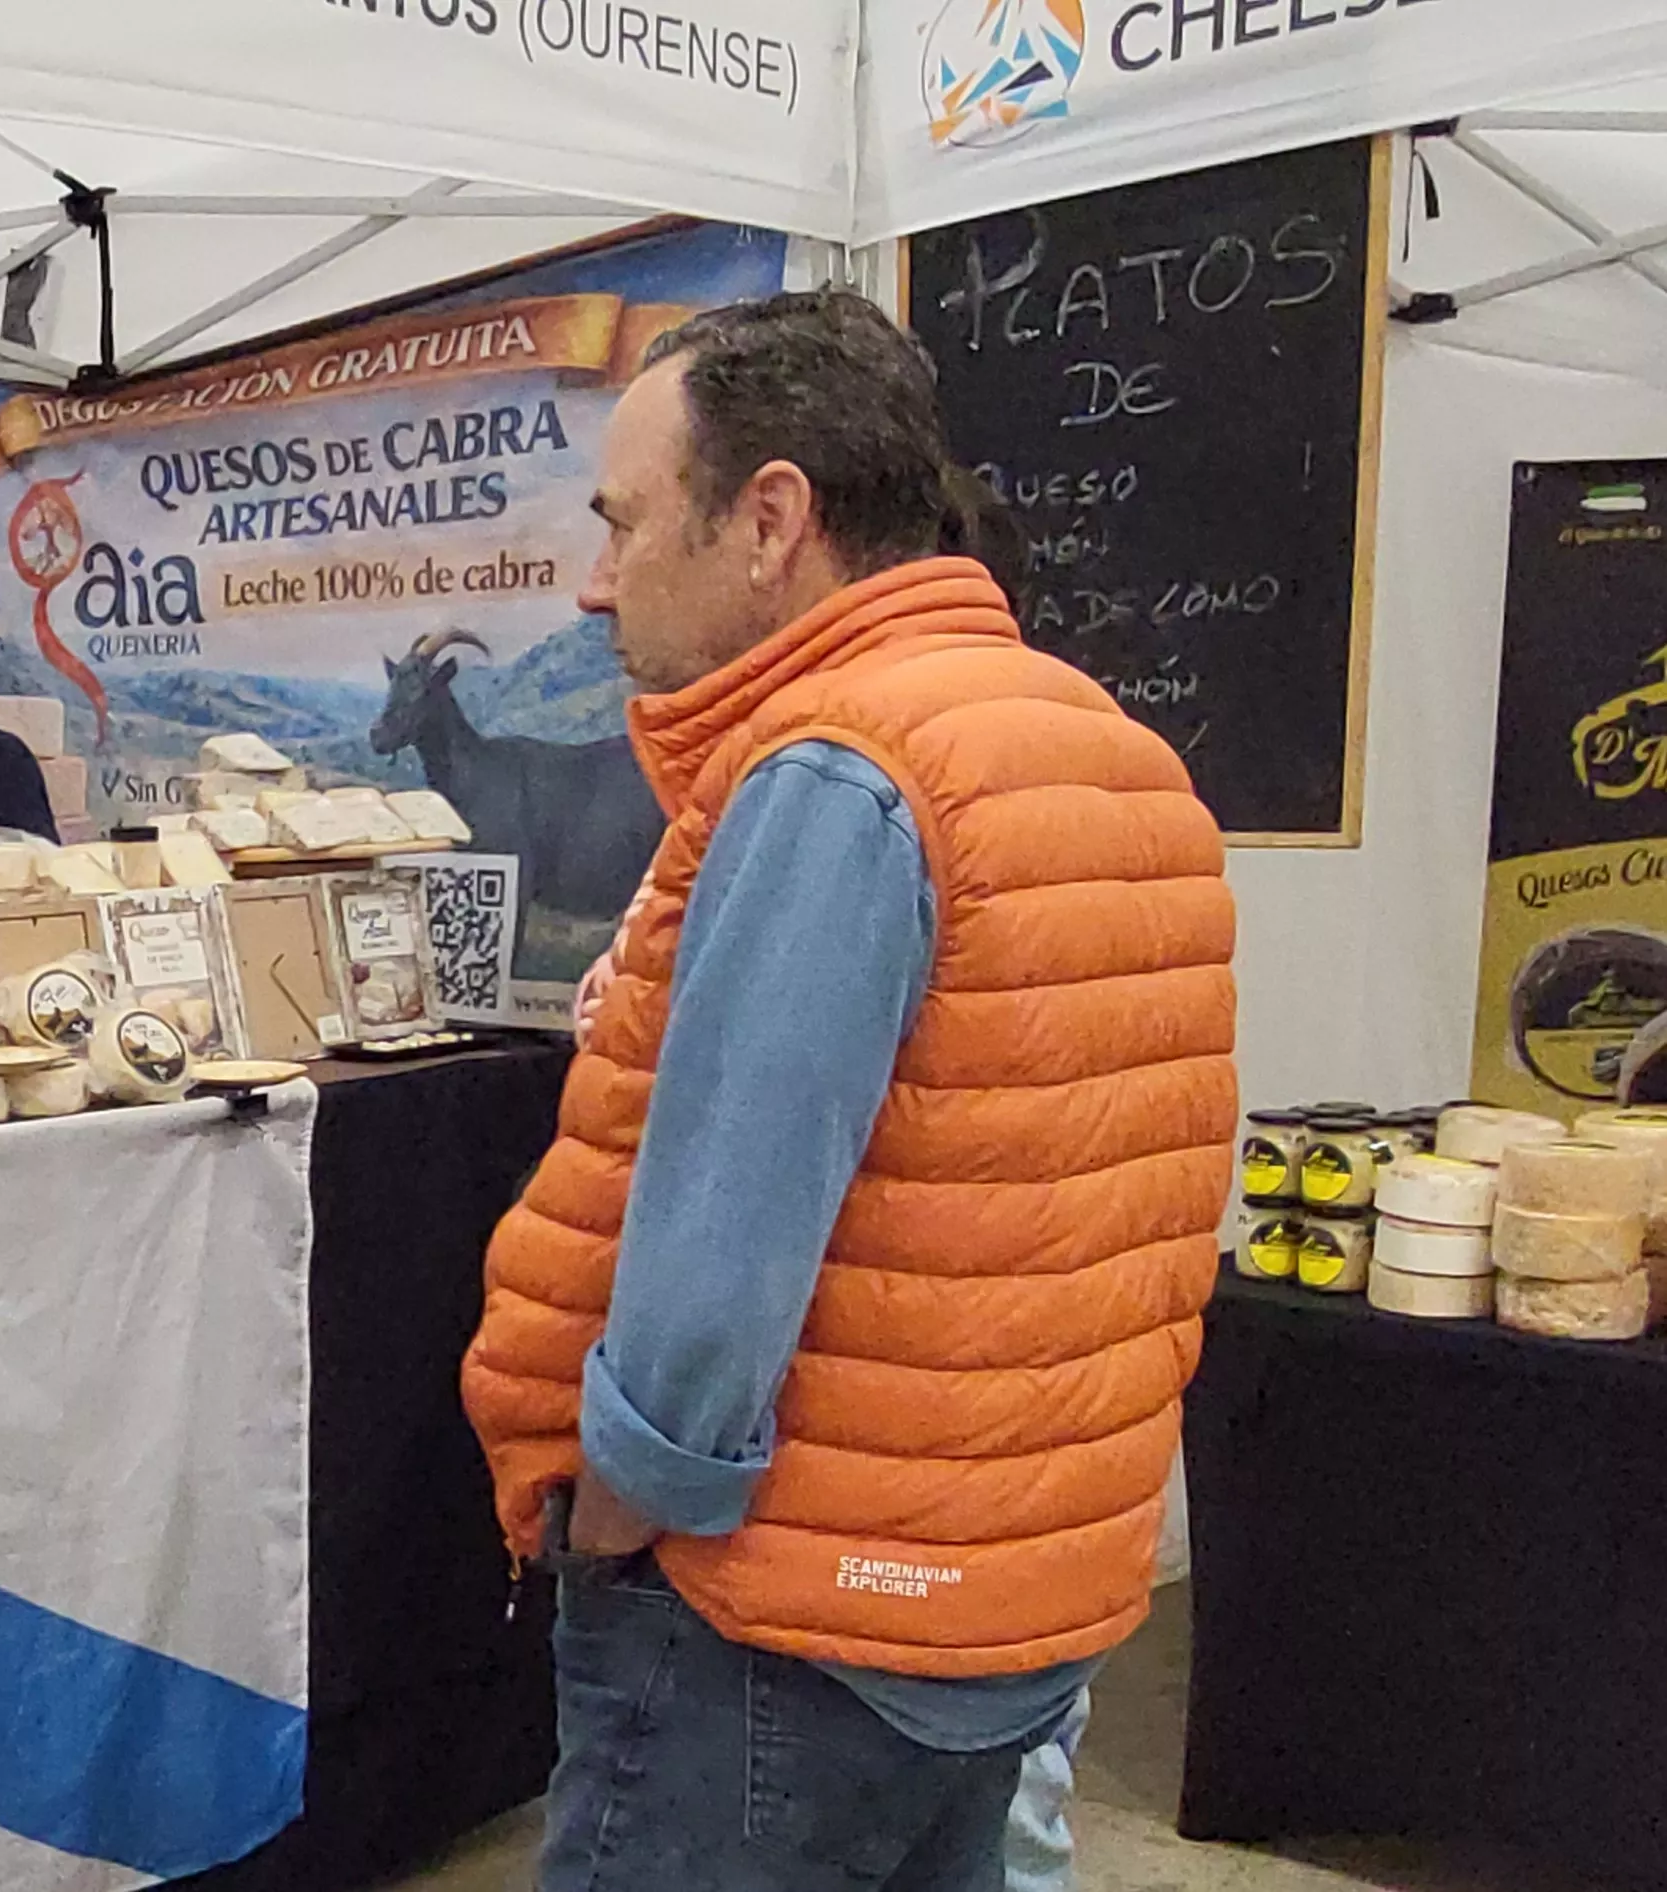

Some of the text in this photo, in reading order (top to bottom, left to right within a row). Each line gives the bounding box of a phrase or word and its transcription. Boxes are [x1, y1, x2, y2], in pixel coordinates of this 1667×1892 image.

[519, 0, 799, 116] (OURENSE)
[939, 207, 1338, 351] PLATOS
[308, 316, 536, 389] GRATUITA
[1060, 361, 1179, 427] DE
[141, 401, 568, 511] QUESOS DE CABRA
[198, 472, 508, 546] ARTESANALES
[224, 551, 556, 608] Leche 100% de cabra
[88, 635, 202, 662] QUEIXERIA
[125, 772, 158, 803] Sin
[1518, 863, 1611, 908] Quesos
[835, 1571, 929, 1599] EXPLORER
[838, 1555, 963, 1585] SCANDINAVIAN
